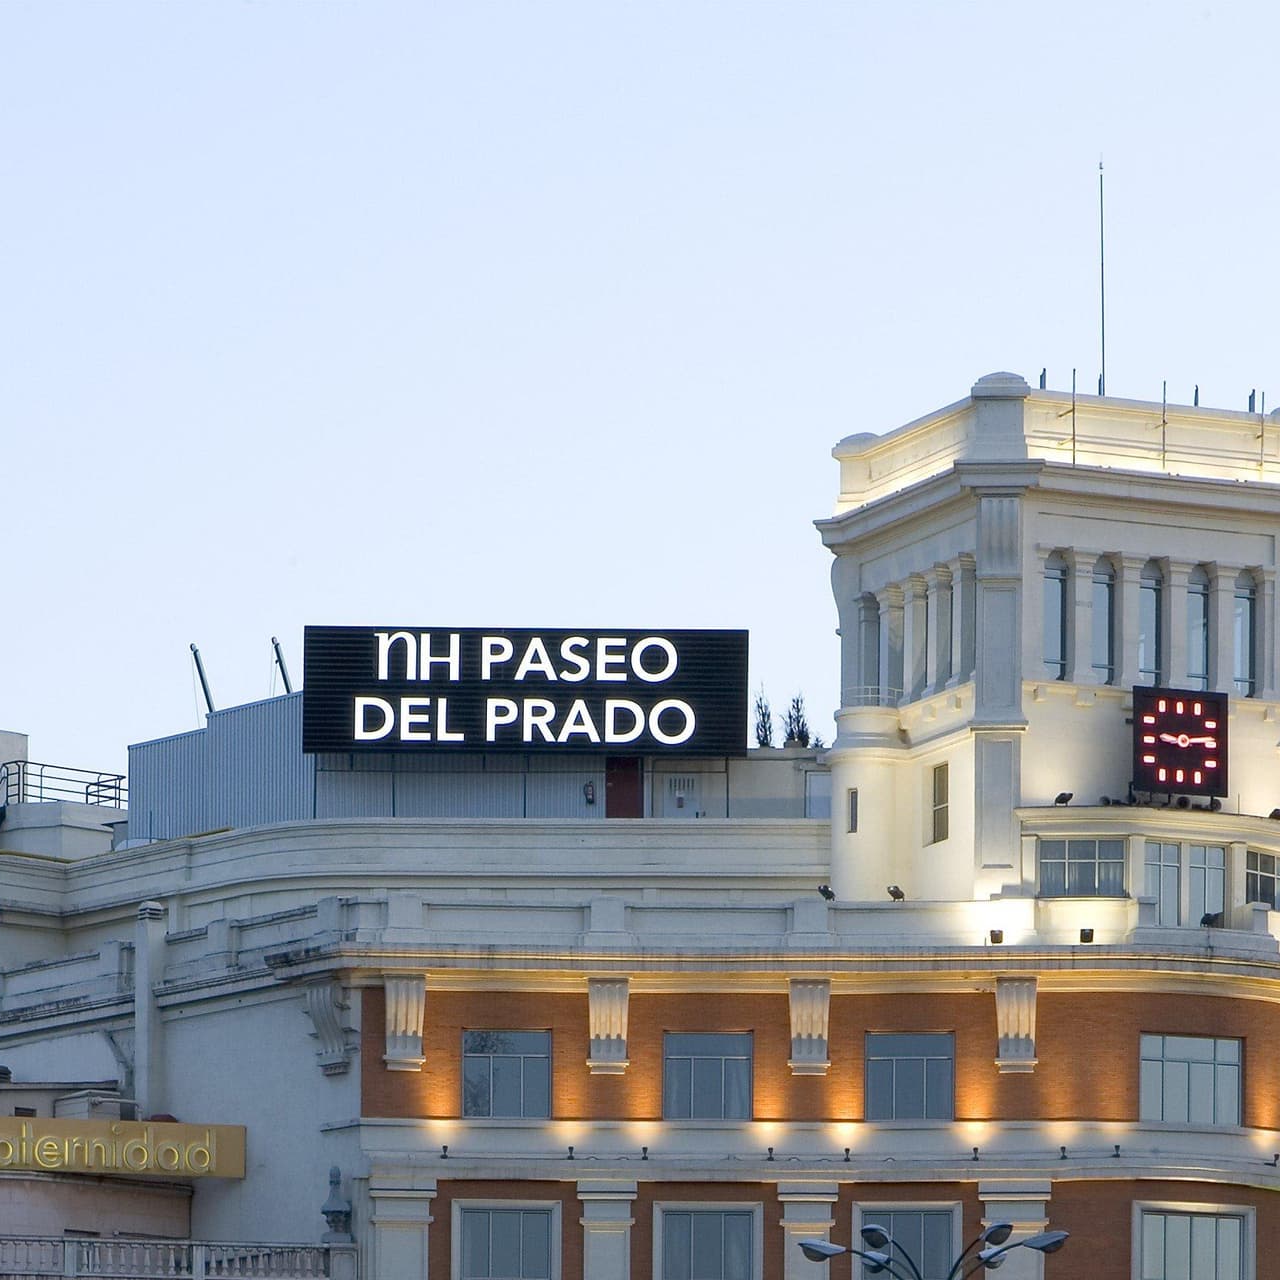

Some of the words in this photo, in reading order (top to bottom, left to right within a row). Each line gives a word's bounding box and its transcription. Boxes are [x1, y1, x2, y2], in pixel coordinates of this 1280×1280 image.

[481, 636, 678, 684] PASEO
[354, 697, 465, 742] DEL
[486, 699, 696, 745] PRADO
